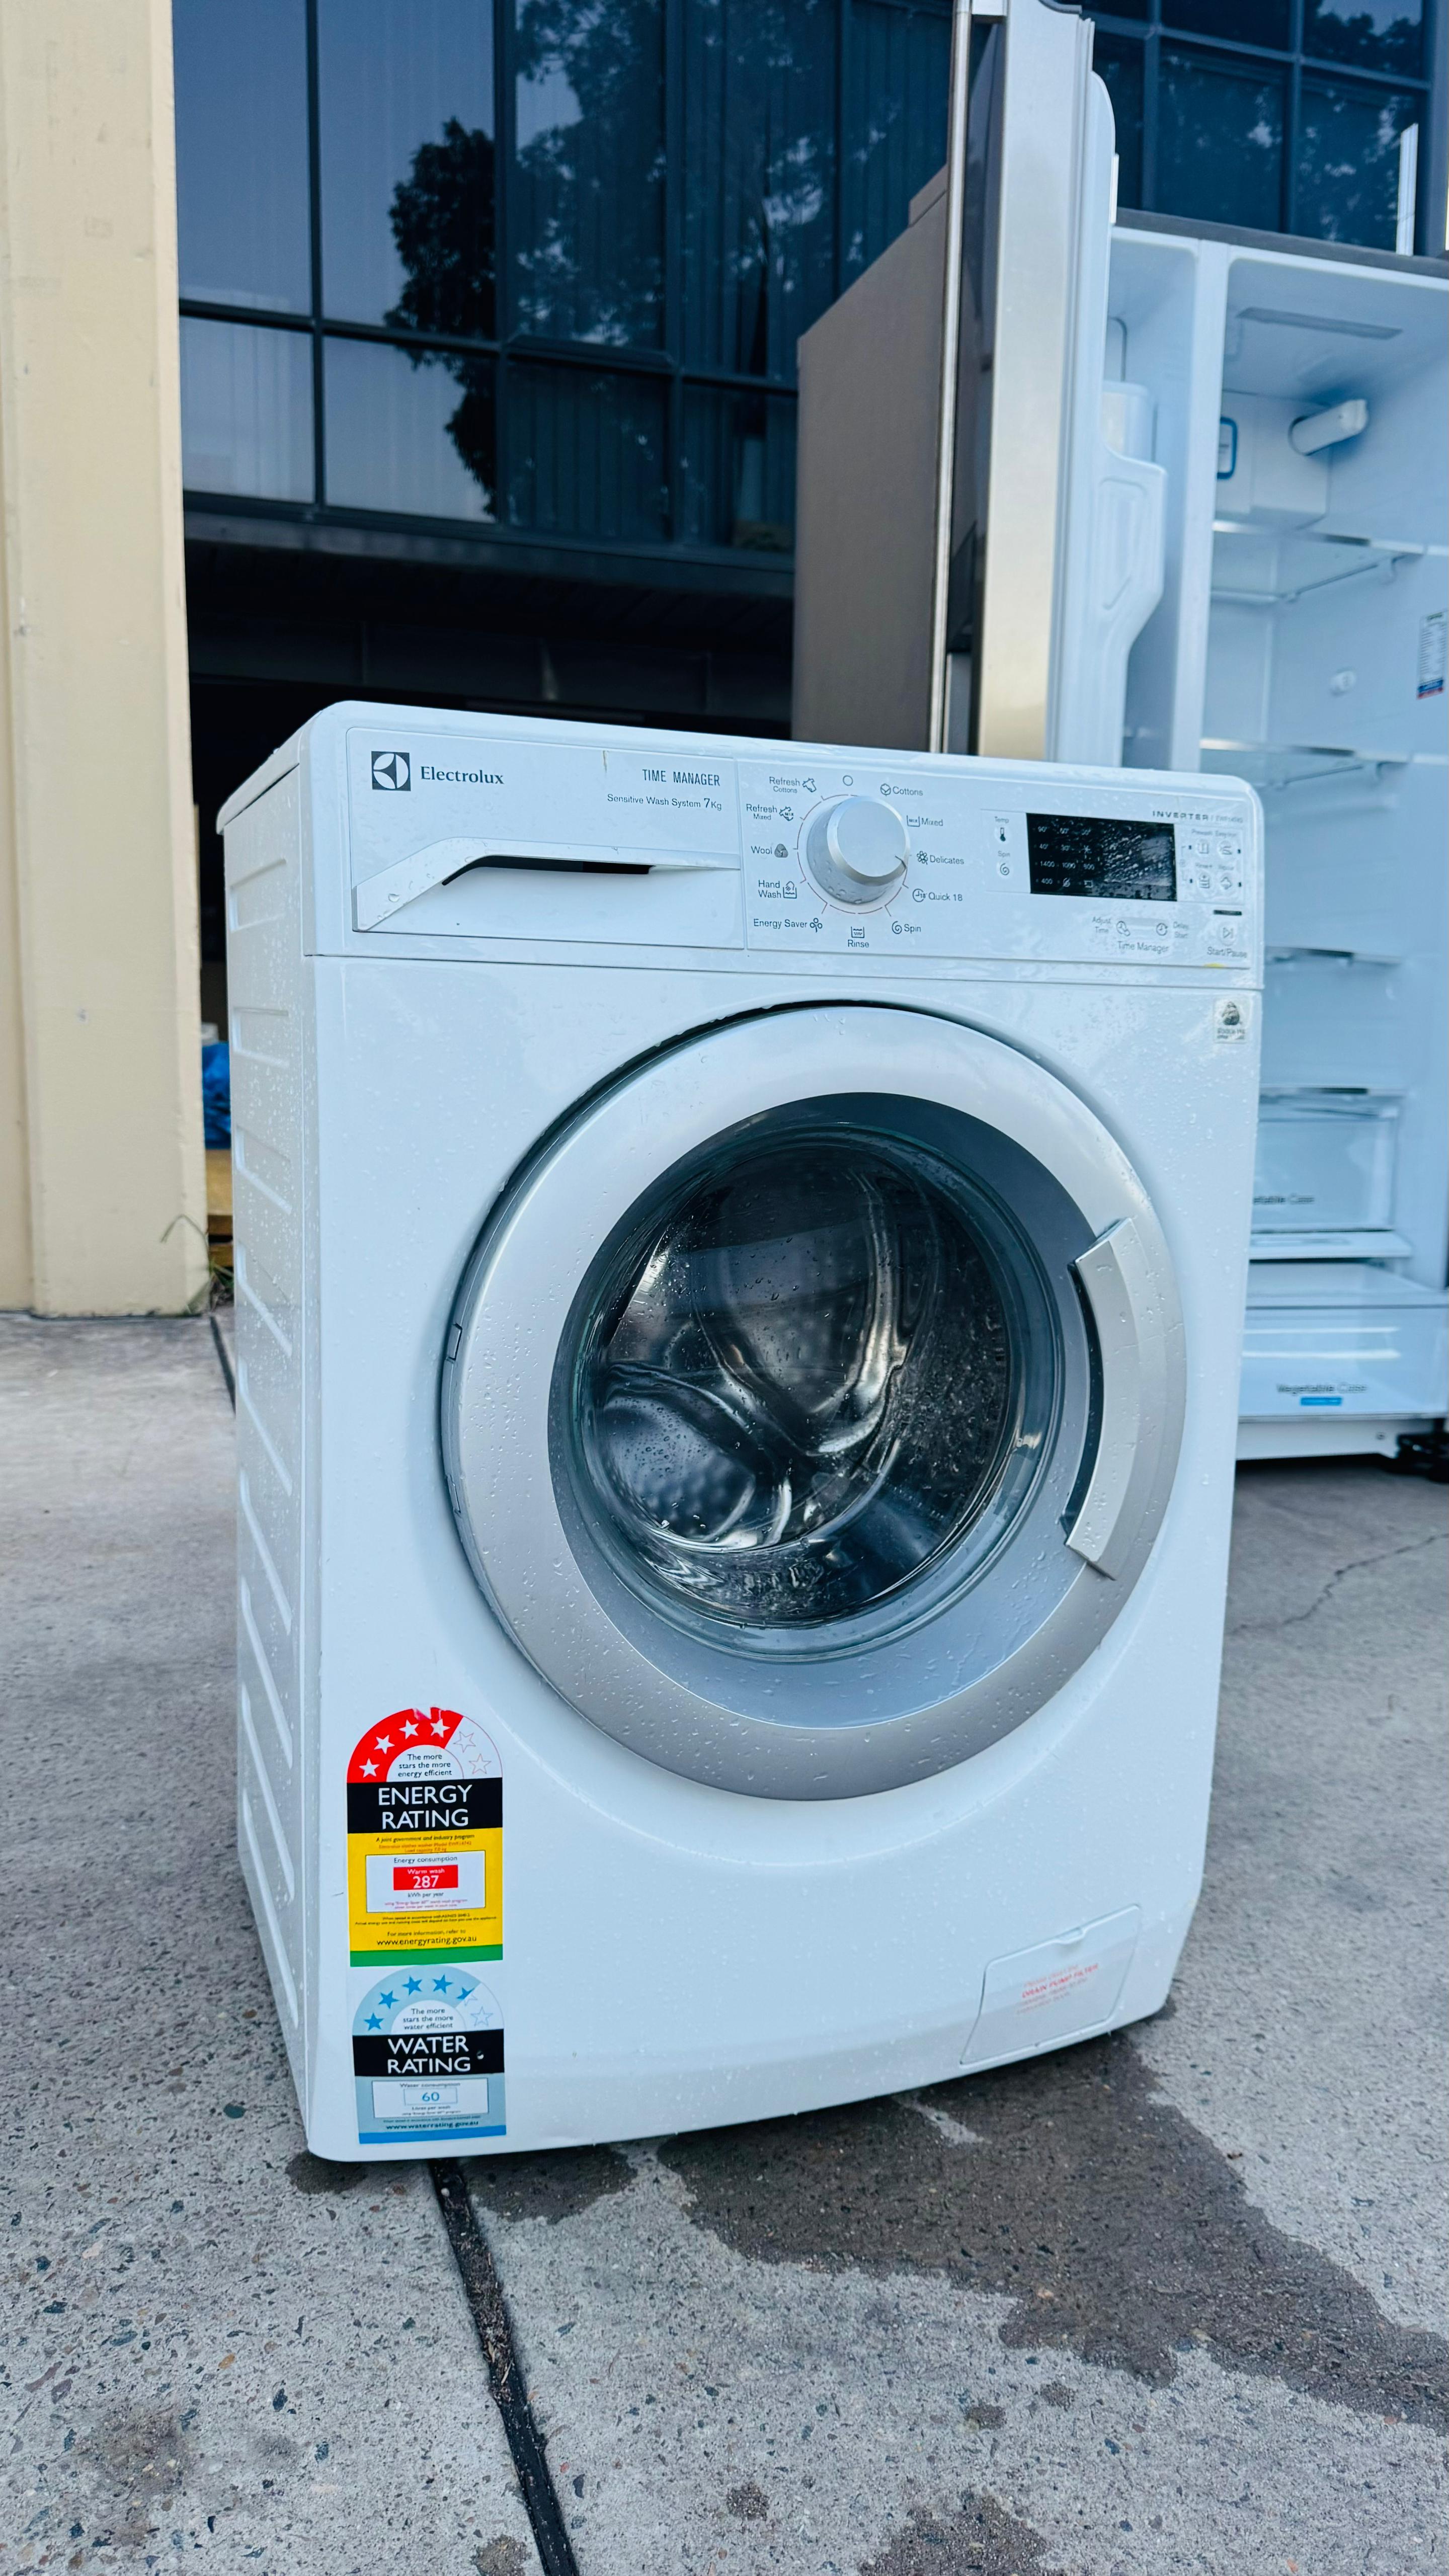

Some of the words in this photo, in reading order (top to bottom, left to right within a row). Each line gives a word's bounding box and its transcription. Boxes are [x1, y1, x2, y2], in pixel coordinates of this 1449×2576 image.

[421, 766, 504, 784] Electrolux
[642, 769, 667, 782] TIME
[673, 772, 720, 786] MANAGER
[769, 777, 800, 786] Refresh
[893, 786, 923, 796] Cottons
[607, 794, 643, 803] Sensitive
[646, 796, 669, 805] Wash
[672, 798, 701, 808] System
[746, 803, 777, 813] Refresh
[1152, 811, 1208, 821] INVERTER
[921, 818, 943, 826] Mixed
[751, 846, 772, 855] Wool
[930, 855, 964, 864] Delicates
[758, 880, 780, 889] Hand
[758, 890, 781, 899] Wash
[928, 892, 950, 901] Quick
[754, 919, 782, 929] Energy
[784, 920, 808, 928] Saver
[904, 924, 921, 933] Spin
[848, 940, 869, 948] Rinse
[1117, 941, 1135, 950] Time
[1138, 942, 1169, 953] Manager
[1208, 946, 1247, 958] Start/Pause
[1276, 1384, 1335, 1396] Vegetable
[378, 1785, 472, 1806] ENERGY
[382, 1809, 468, 1830] RATING
[413, 1875, 439, 1889] 287
[377, 1937, 477, 1947] www.energyrating.gov.au
[387, 2035, 469, 2055] WATER
[387, 2057, 471, 2074] RATING
[422, 2091, 440, 2102] 60
[386, 2121, 479, 2130] www.waterrating.gov.au
